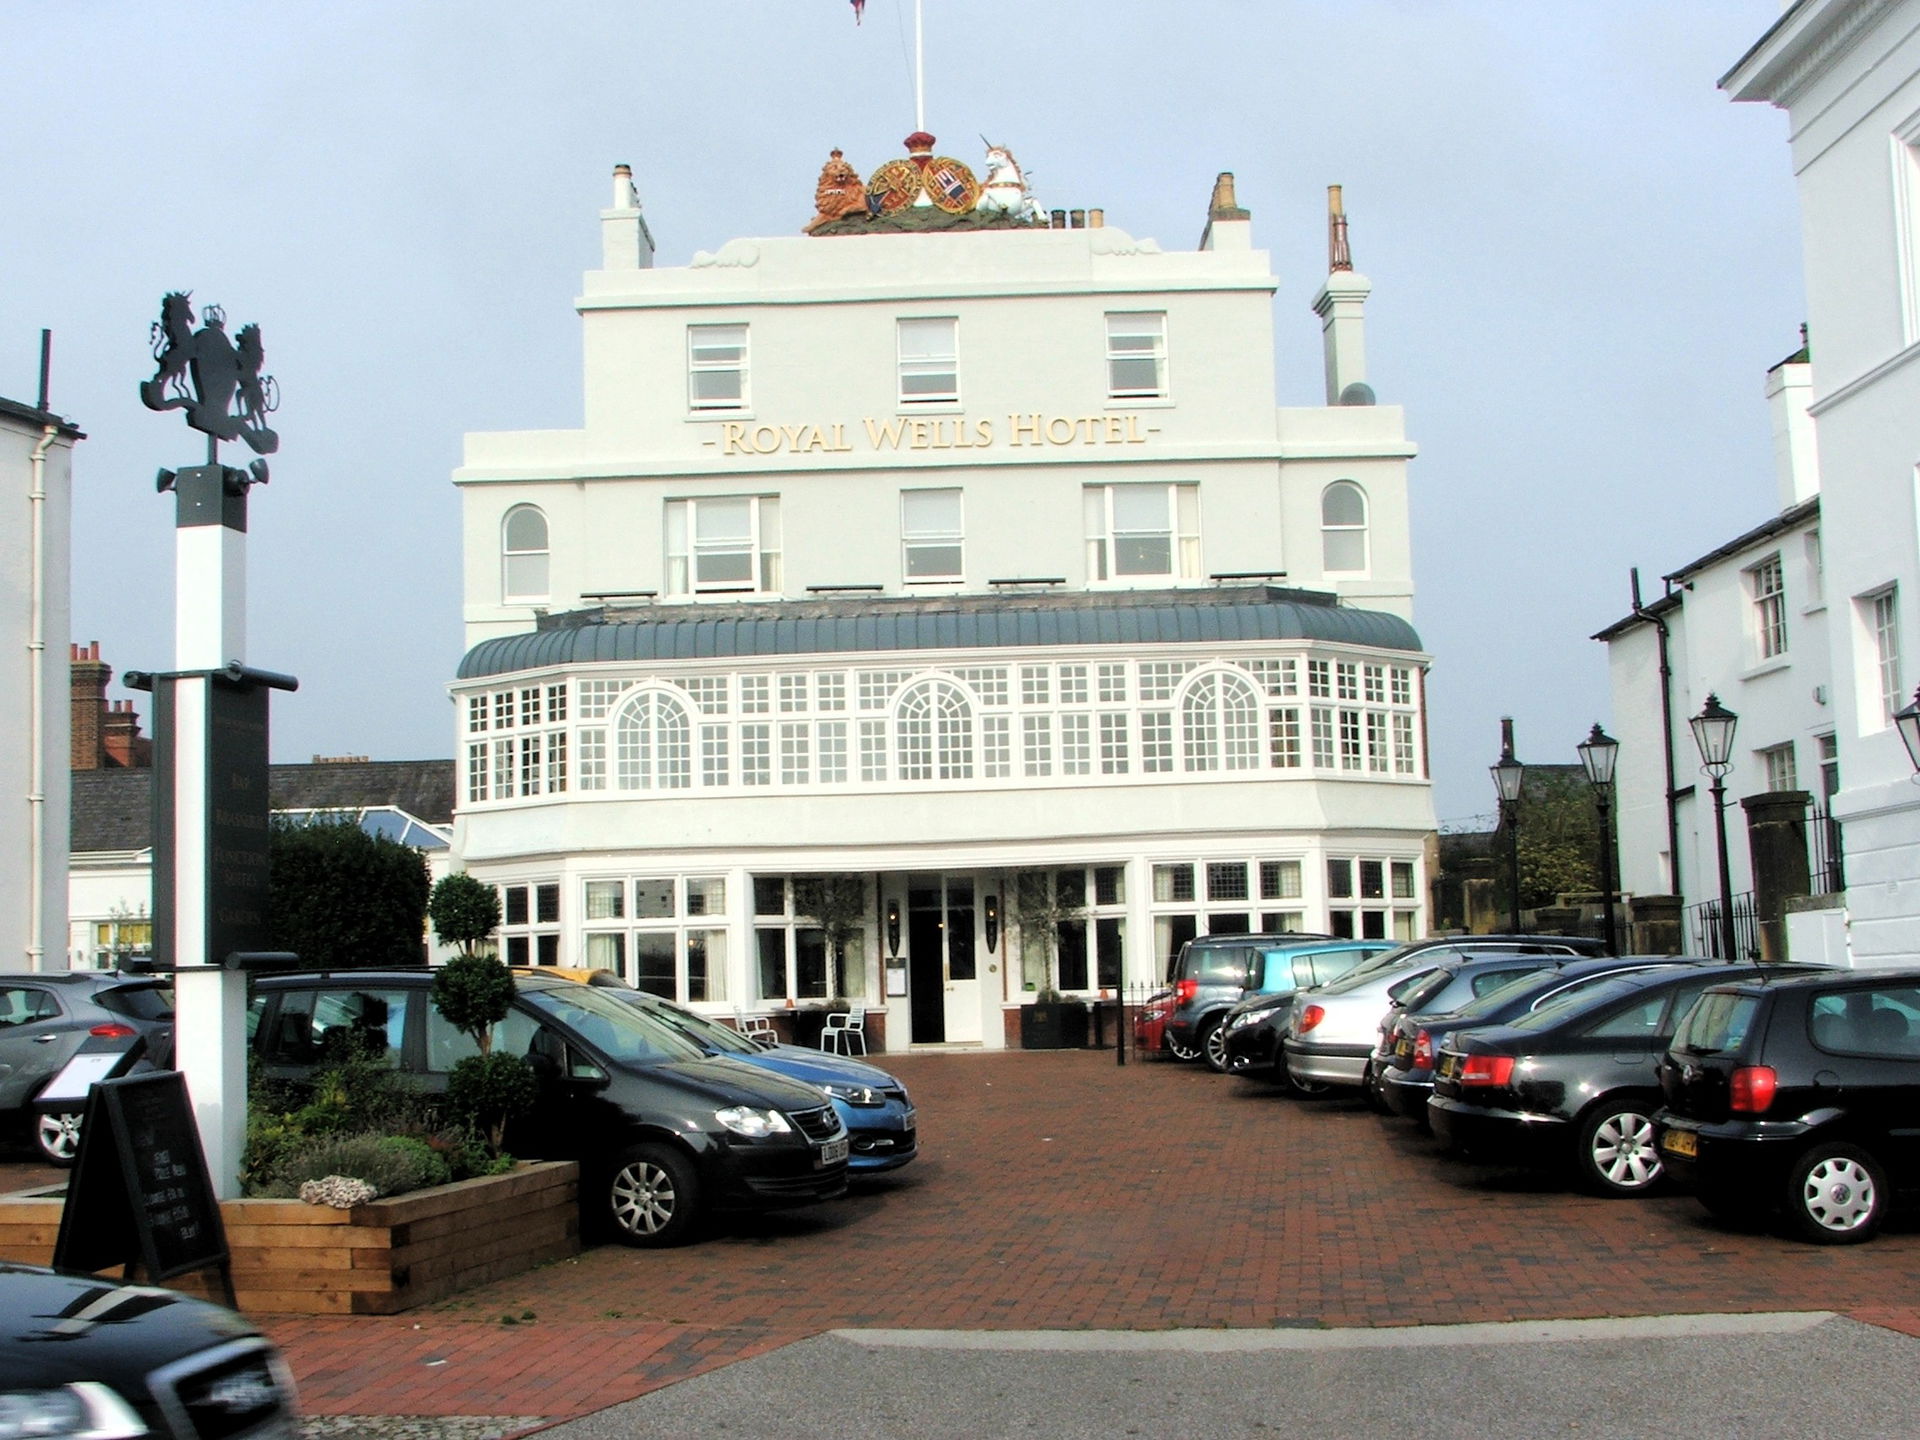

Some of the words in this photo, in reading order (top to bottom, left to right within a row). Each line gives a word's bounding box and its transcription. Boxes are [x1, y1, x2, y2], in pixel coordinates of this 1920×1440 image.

[722, 421, 852, 455] ROYAL
[863, 416, 994, 450] WELLS
[1008, 412, 1147, 446] HOTEL
